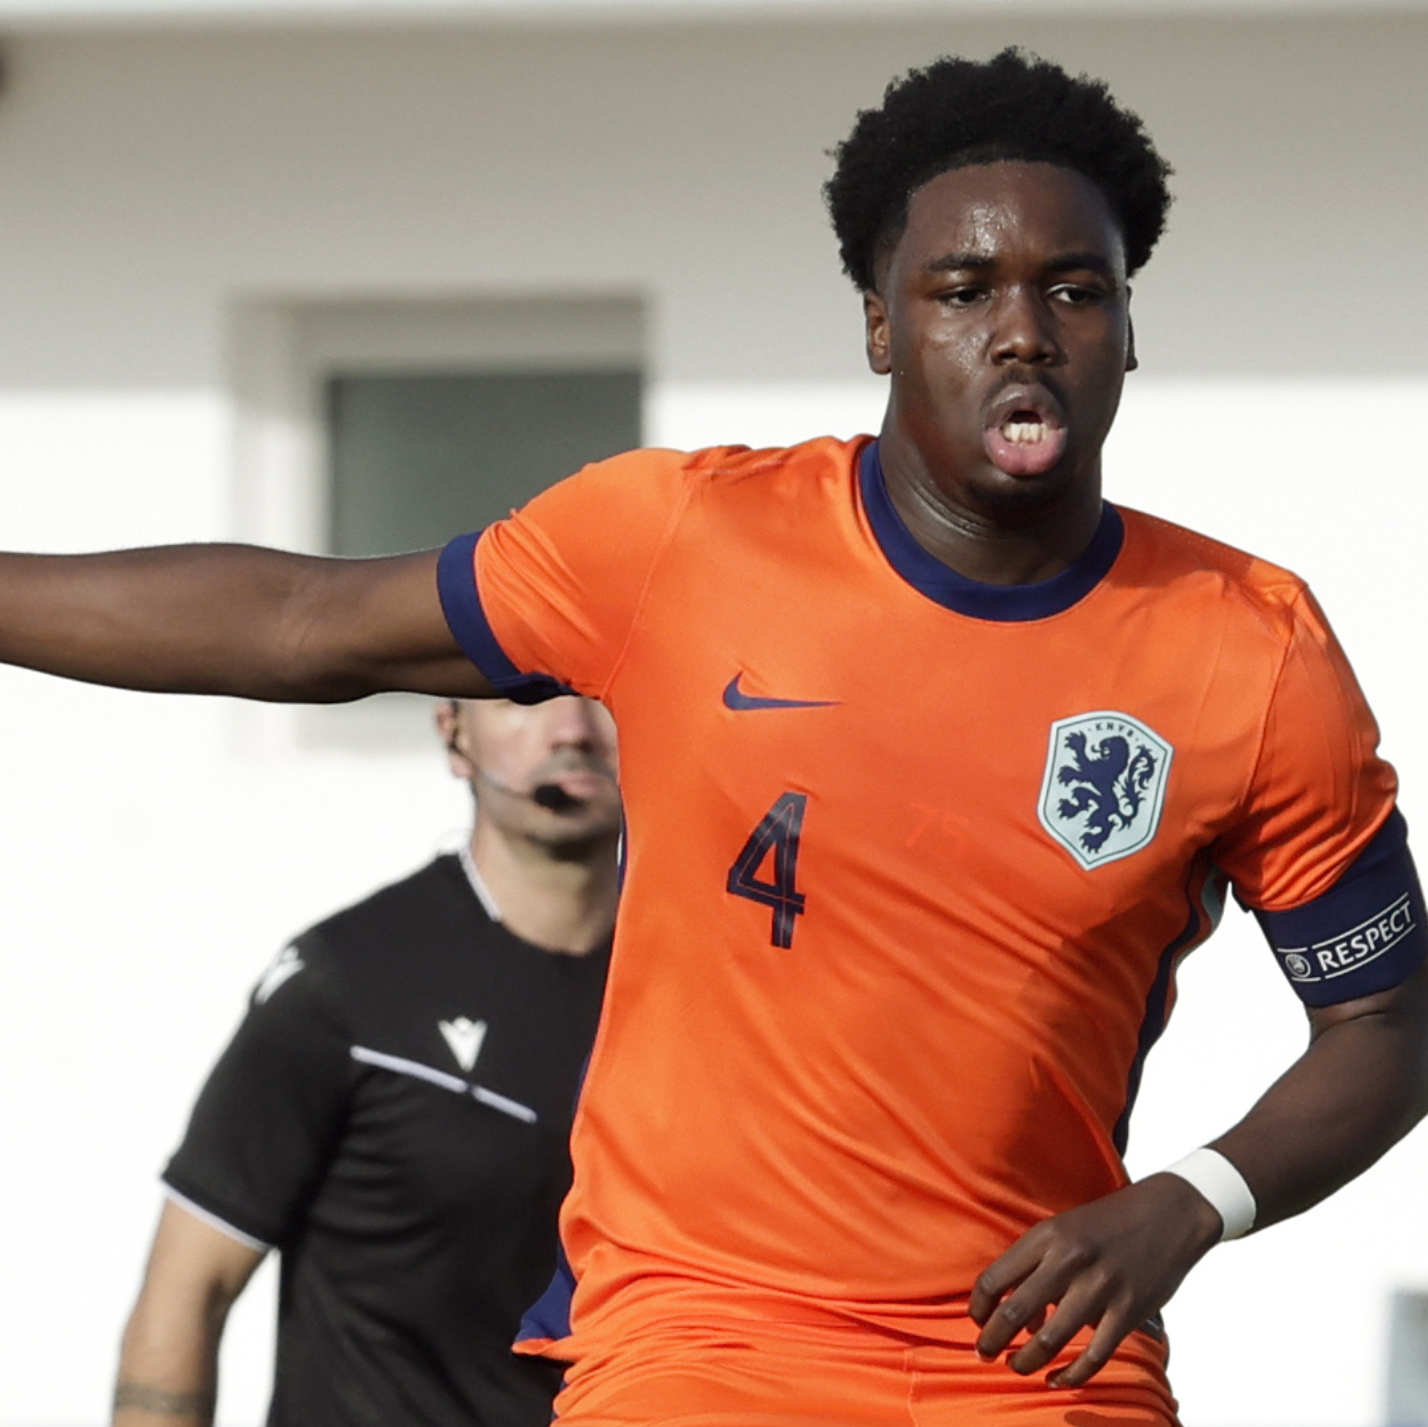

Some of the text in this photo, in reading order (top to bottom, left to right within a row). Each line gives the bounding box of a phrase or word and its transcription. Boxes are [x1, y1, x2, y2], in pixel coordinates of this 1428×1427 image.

[1095, 722, 1135, 738] KNVB
[726, 792, 809, 950] 4
[1316, 900, 1413, 971] RESPECT
